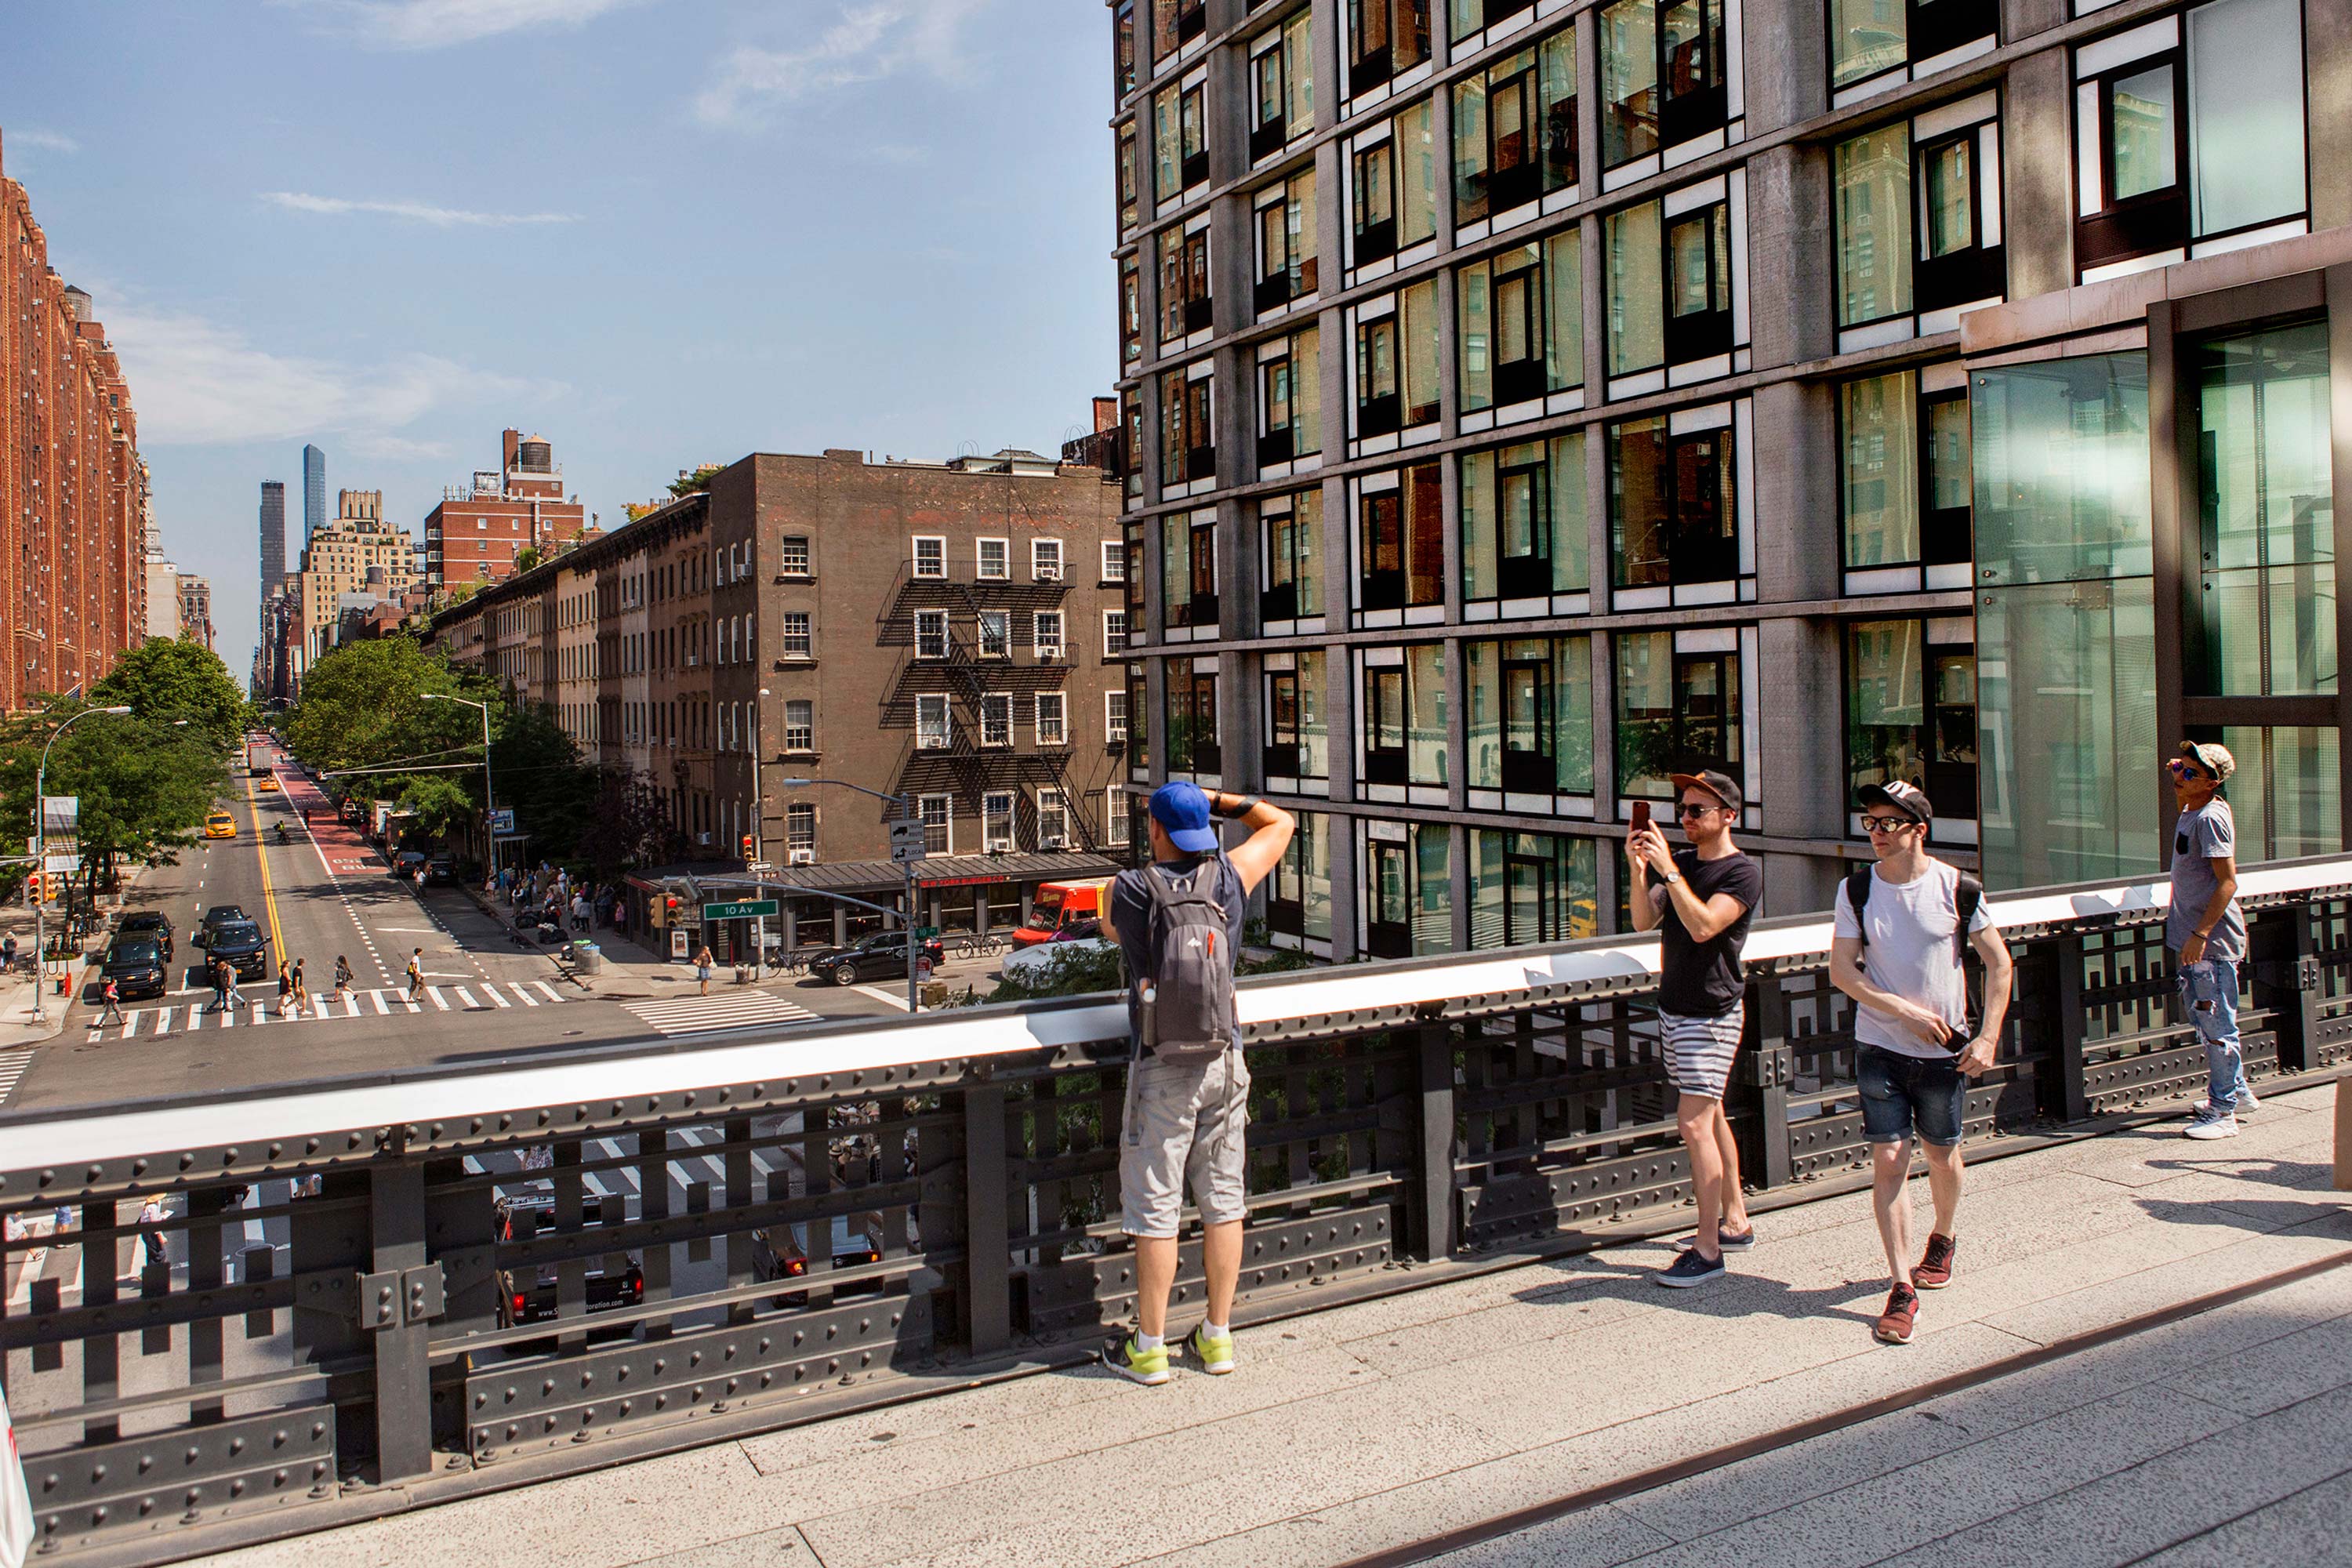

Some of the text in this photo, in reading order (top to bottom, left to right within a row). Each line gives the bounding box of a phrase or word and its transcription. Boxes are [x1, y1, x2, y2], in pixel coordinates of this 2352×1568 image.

[961, 876, 992, 885] BURGER
[724, 906, 753, 915] 10 Av
